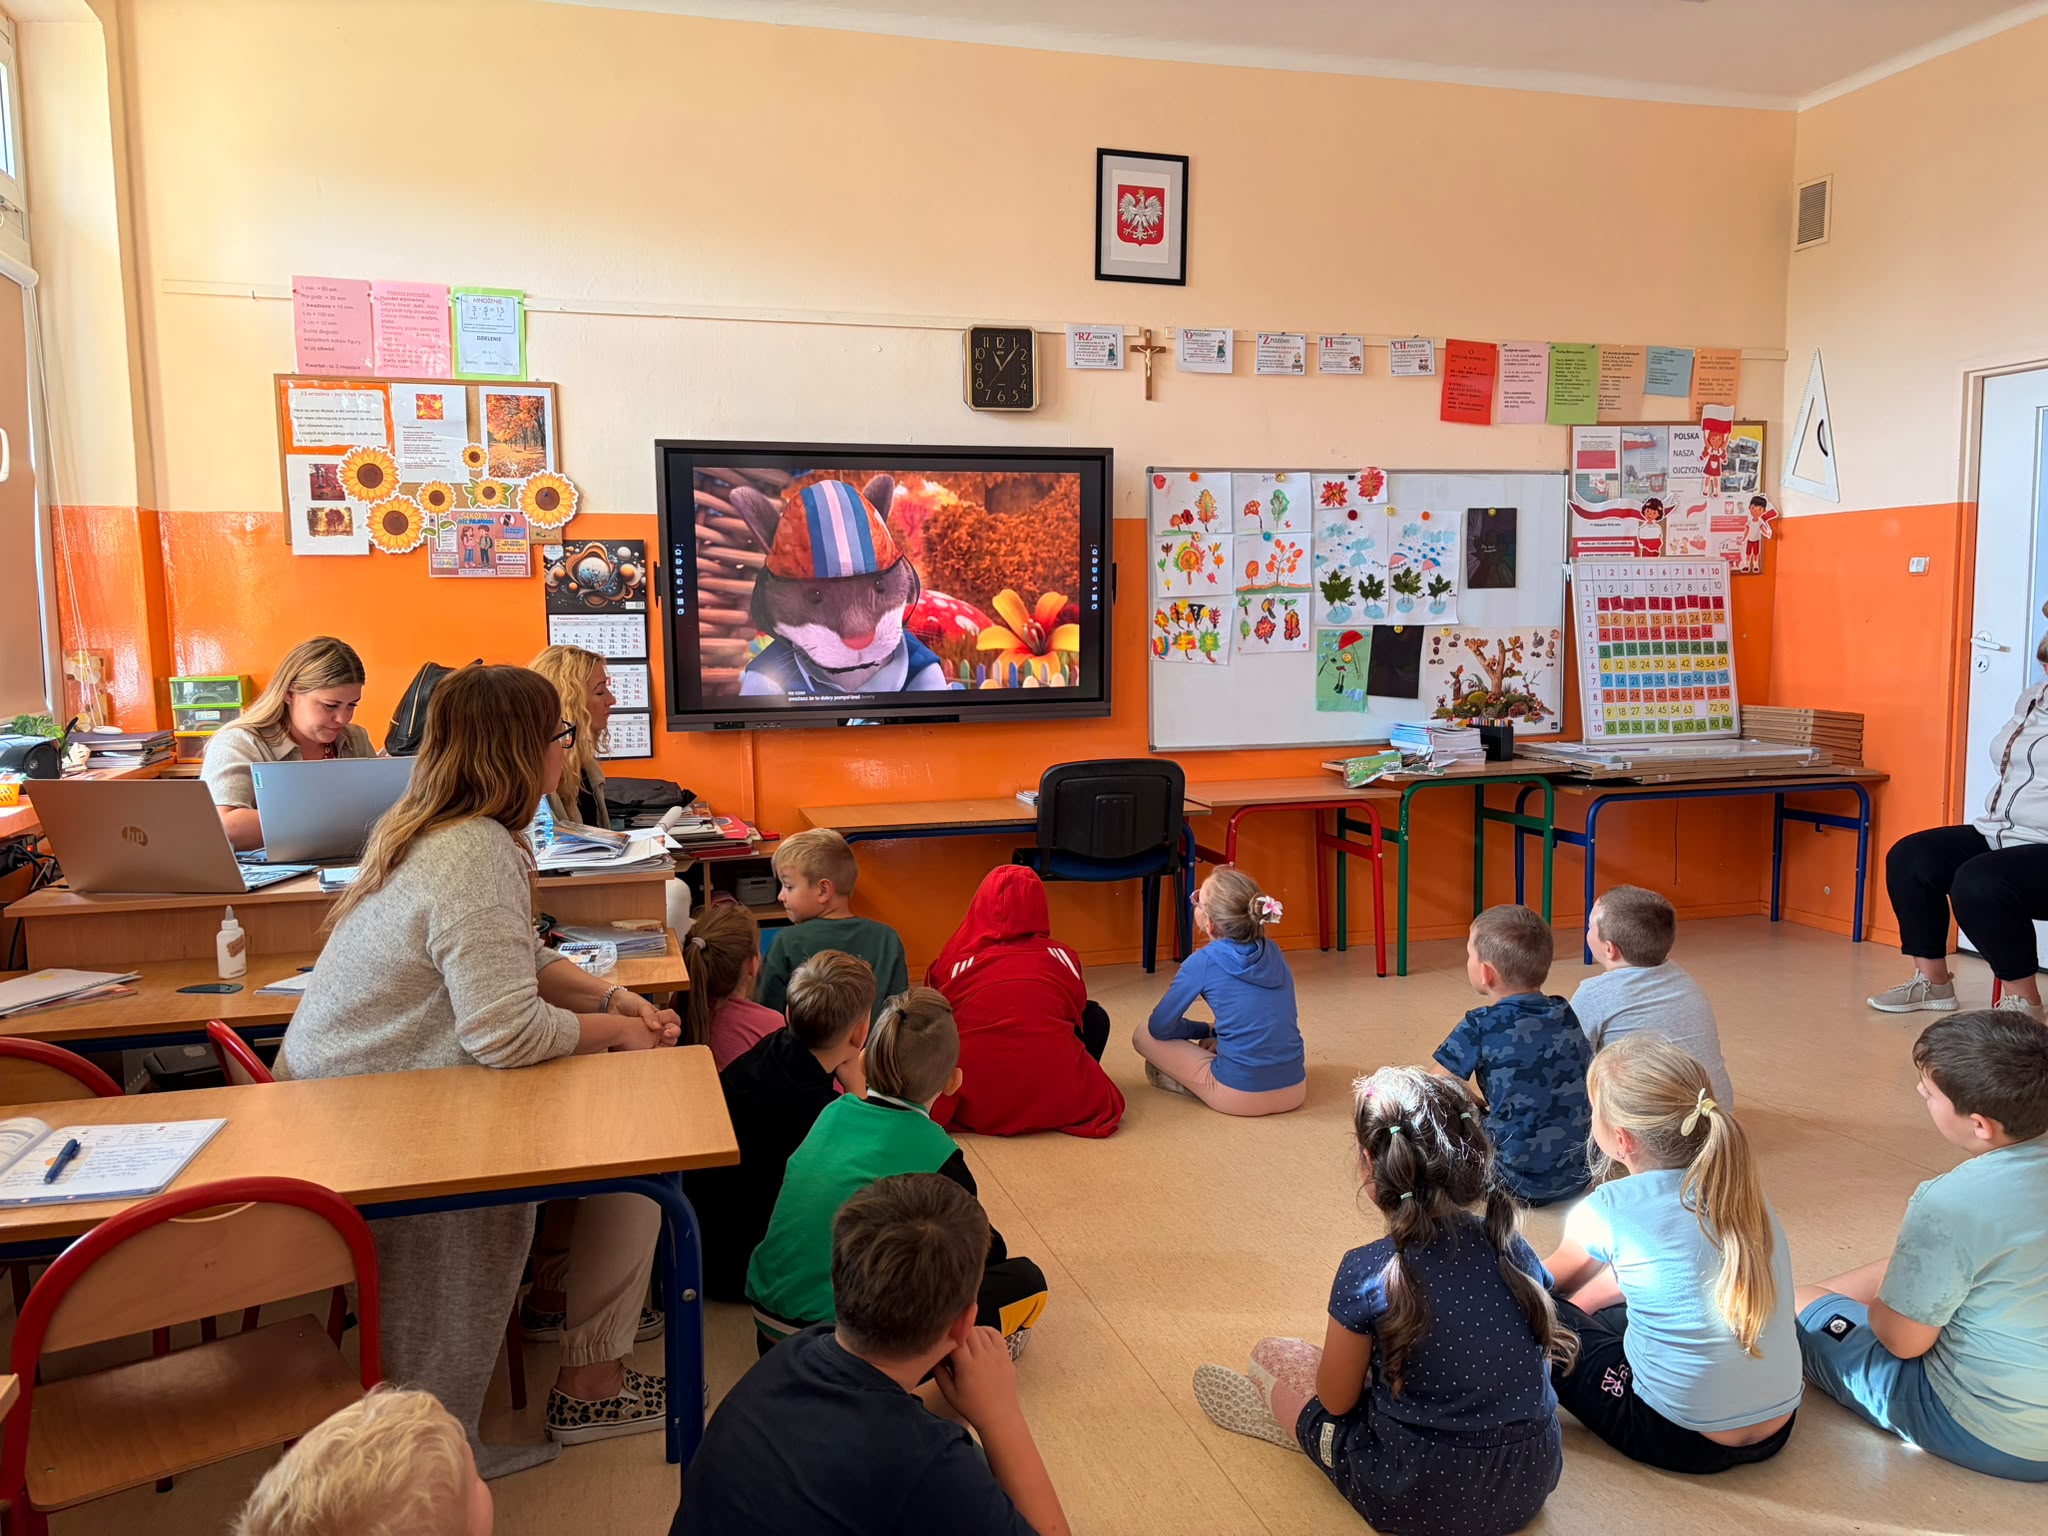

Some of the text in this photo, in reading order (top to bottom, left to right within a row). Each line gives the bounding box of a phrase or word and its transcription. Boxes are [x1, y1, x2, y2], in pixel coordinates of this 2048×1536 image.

[984, 336, 989, 348] 11
[997, 337, 1005, 348] 12
[1013, 337, 1016, 348] 1
[976, 348, 985, 359] 10
[1020, 349, 1026, 360] 2
[975, 363, 982, 374] 9
[1021, 364, 1026, 375] 3
[976, 378, 983, 389] 8
[1020, 379, 1026, 390] 4
[985, 390, 990, 400] 7
[998, 391, 1005, 402] 6
[1013, 390, 1018, 401] 5
[1609, 585, 1614, 593] 2
[1655, 676, 1664, 684] 35
[1644, 691, 1653, 699] 32
[1694, 689, 1703, 697] 64
[1607, 708, 1611, 716] 9
[1645, 706, 1654, 714] 36
[1710, 704, 1718, 712] 72
[1659, 721, 1667, 729] 50
[1674, 723, 1682, 731] 60
[1696, 721, 1706, 729] 80
